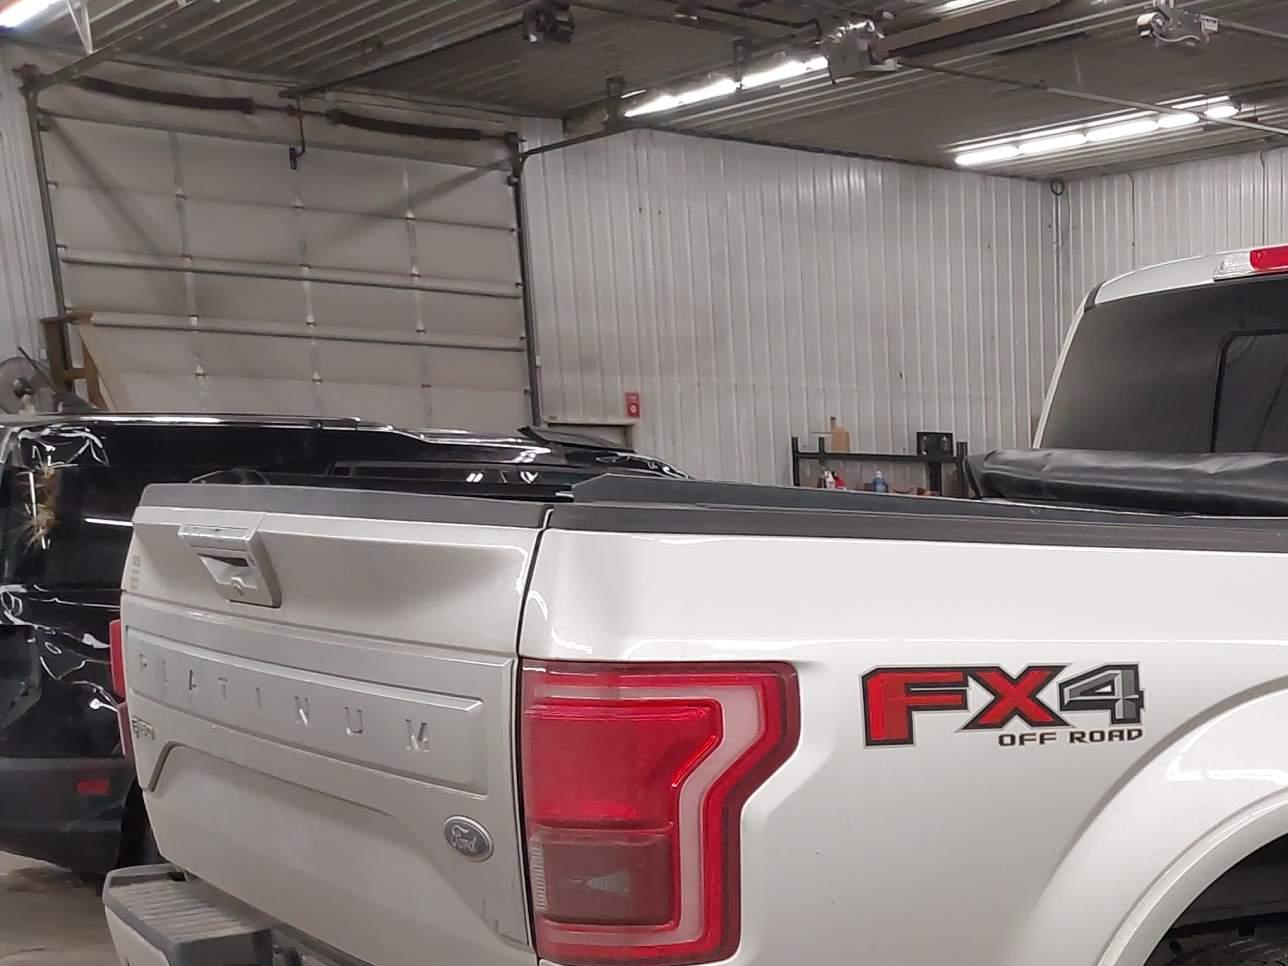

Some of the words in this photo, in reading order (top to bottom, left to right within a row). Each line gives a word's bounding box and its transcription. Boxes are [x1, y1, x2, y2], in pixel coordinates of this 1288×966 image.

[860, 663, 1145, 748] FX4
[998, 732, 1057, 747] OFF
[1069, 728, 1144, 745] ROAD
